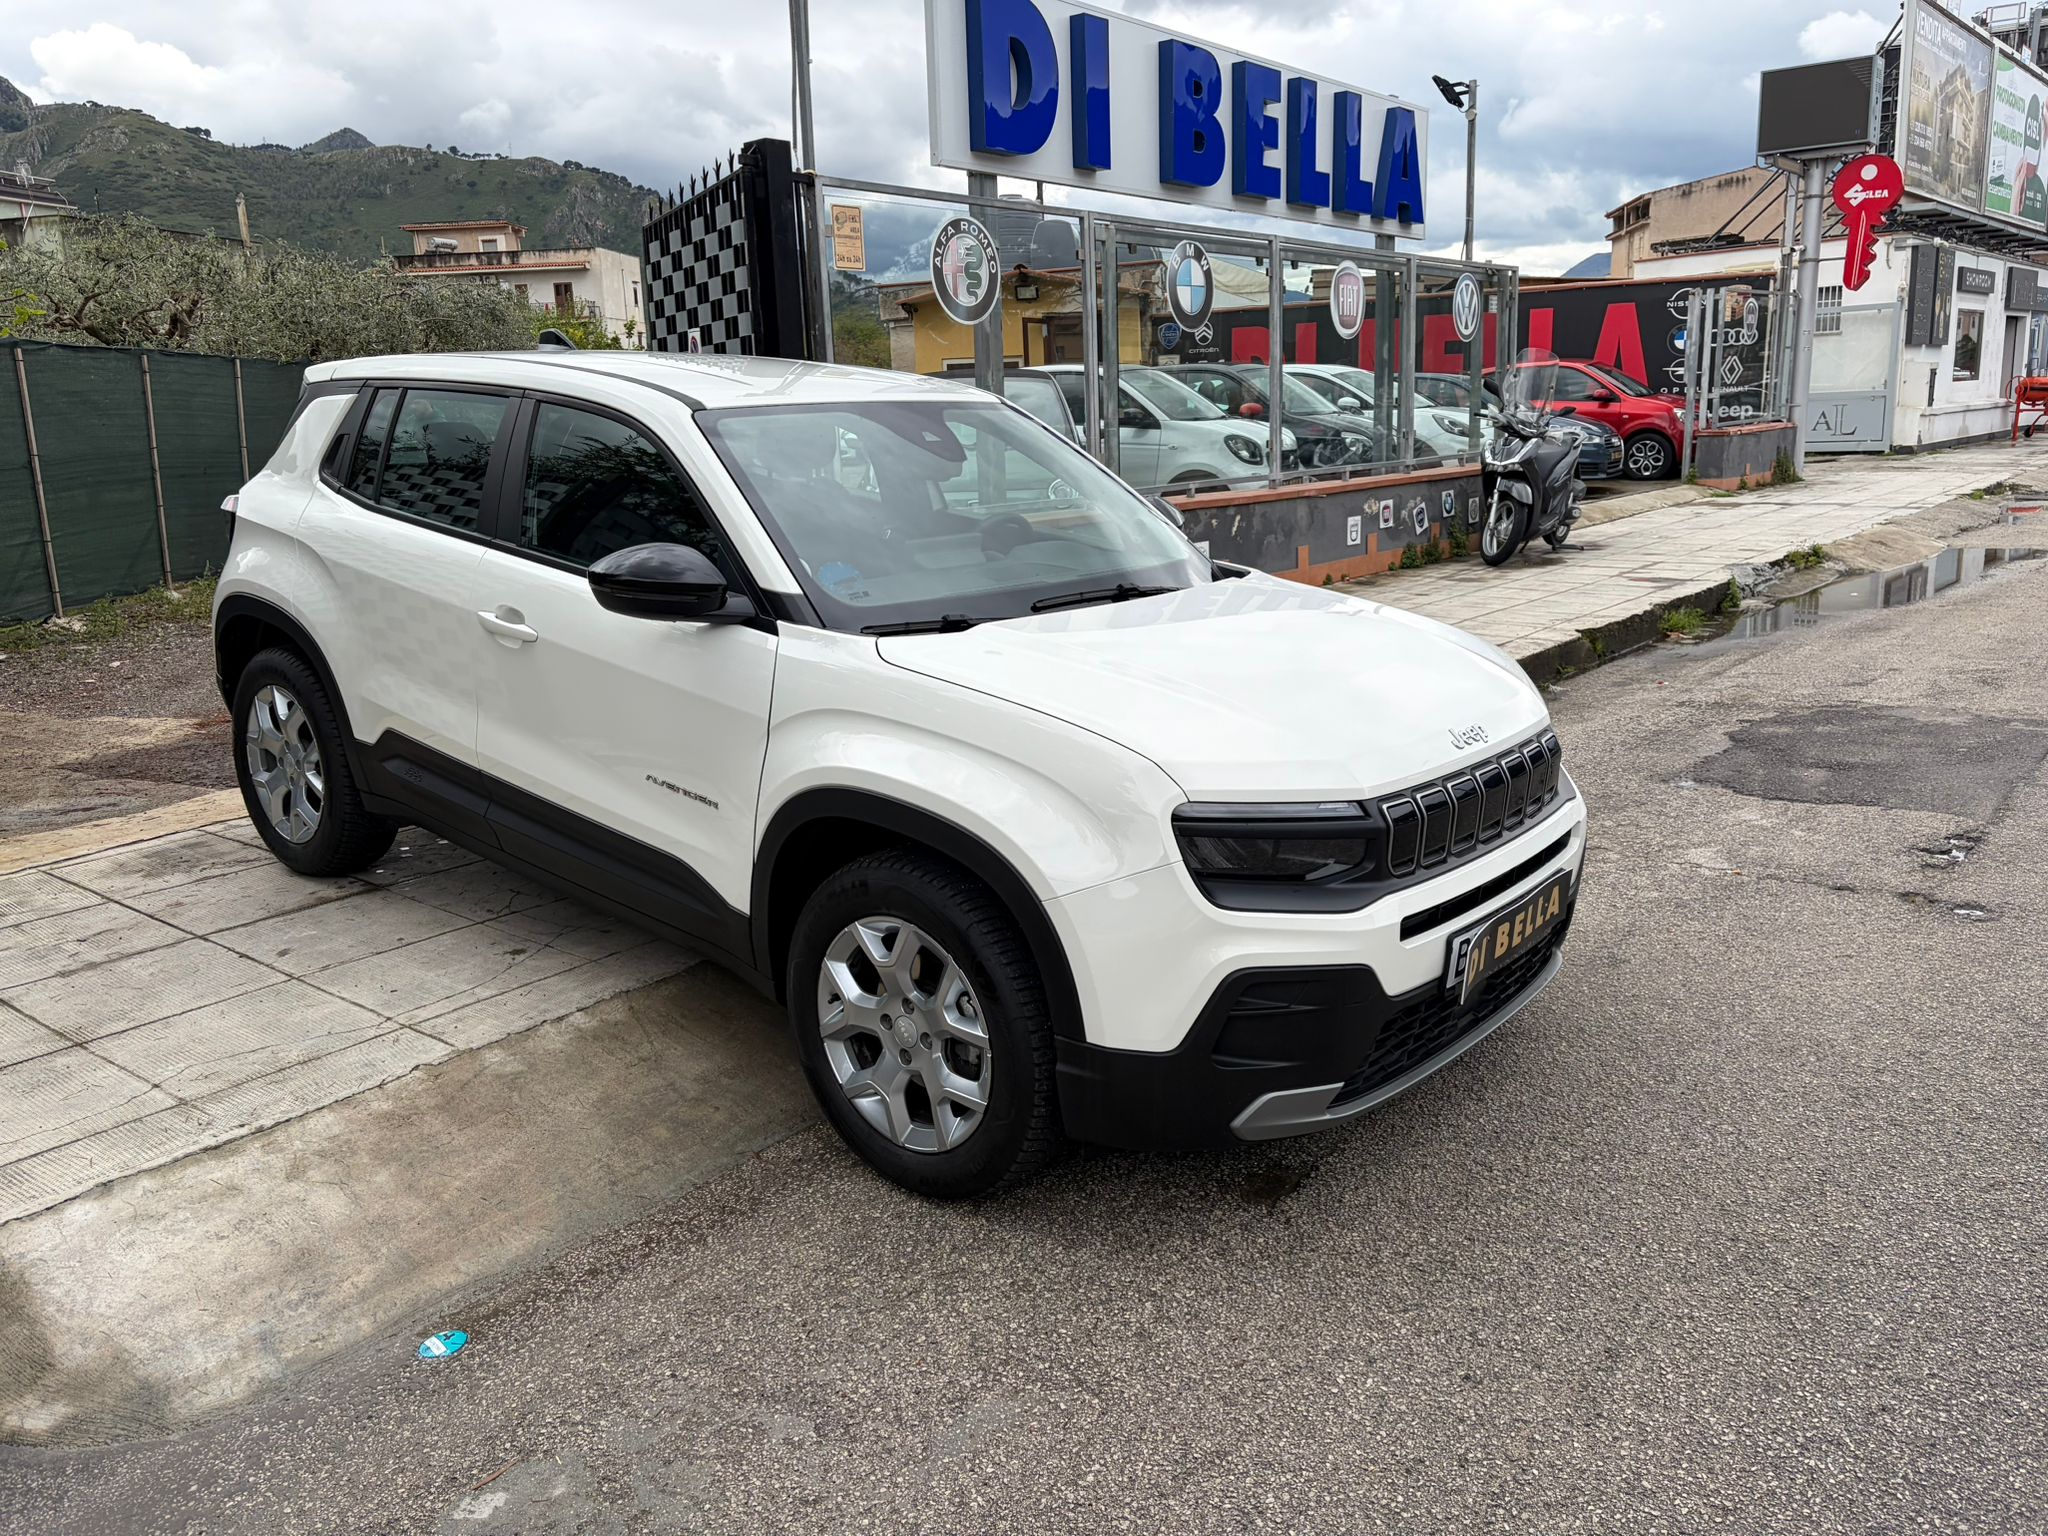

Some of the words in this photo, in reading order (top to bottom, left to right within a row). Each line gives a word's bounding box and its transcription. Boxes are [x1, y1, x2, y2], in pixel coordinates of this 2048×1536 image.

[965, 0, 1111, 170] DI
[1159, 39, 1424, 224] BELLA
[2027, 116, 2040, 140] CISL
[1843, 183, 1889, 208] SILCA
[935, 225, 956, 268] ALFA
[960, 221, 997, 273] ROMEO
[1172, 243, 1209, 271] BMW
[1966, 272, 1992, 288] SHOWROOM
[1339, 284, 1359, 316] FIAT
[1448, 722, 1488, 749] Jeep
[645, 774, 719, 810] AVENGER
[1467, 936, 1490, 986] DI
[1494, 884, 1560, 960] BELLA
